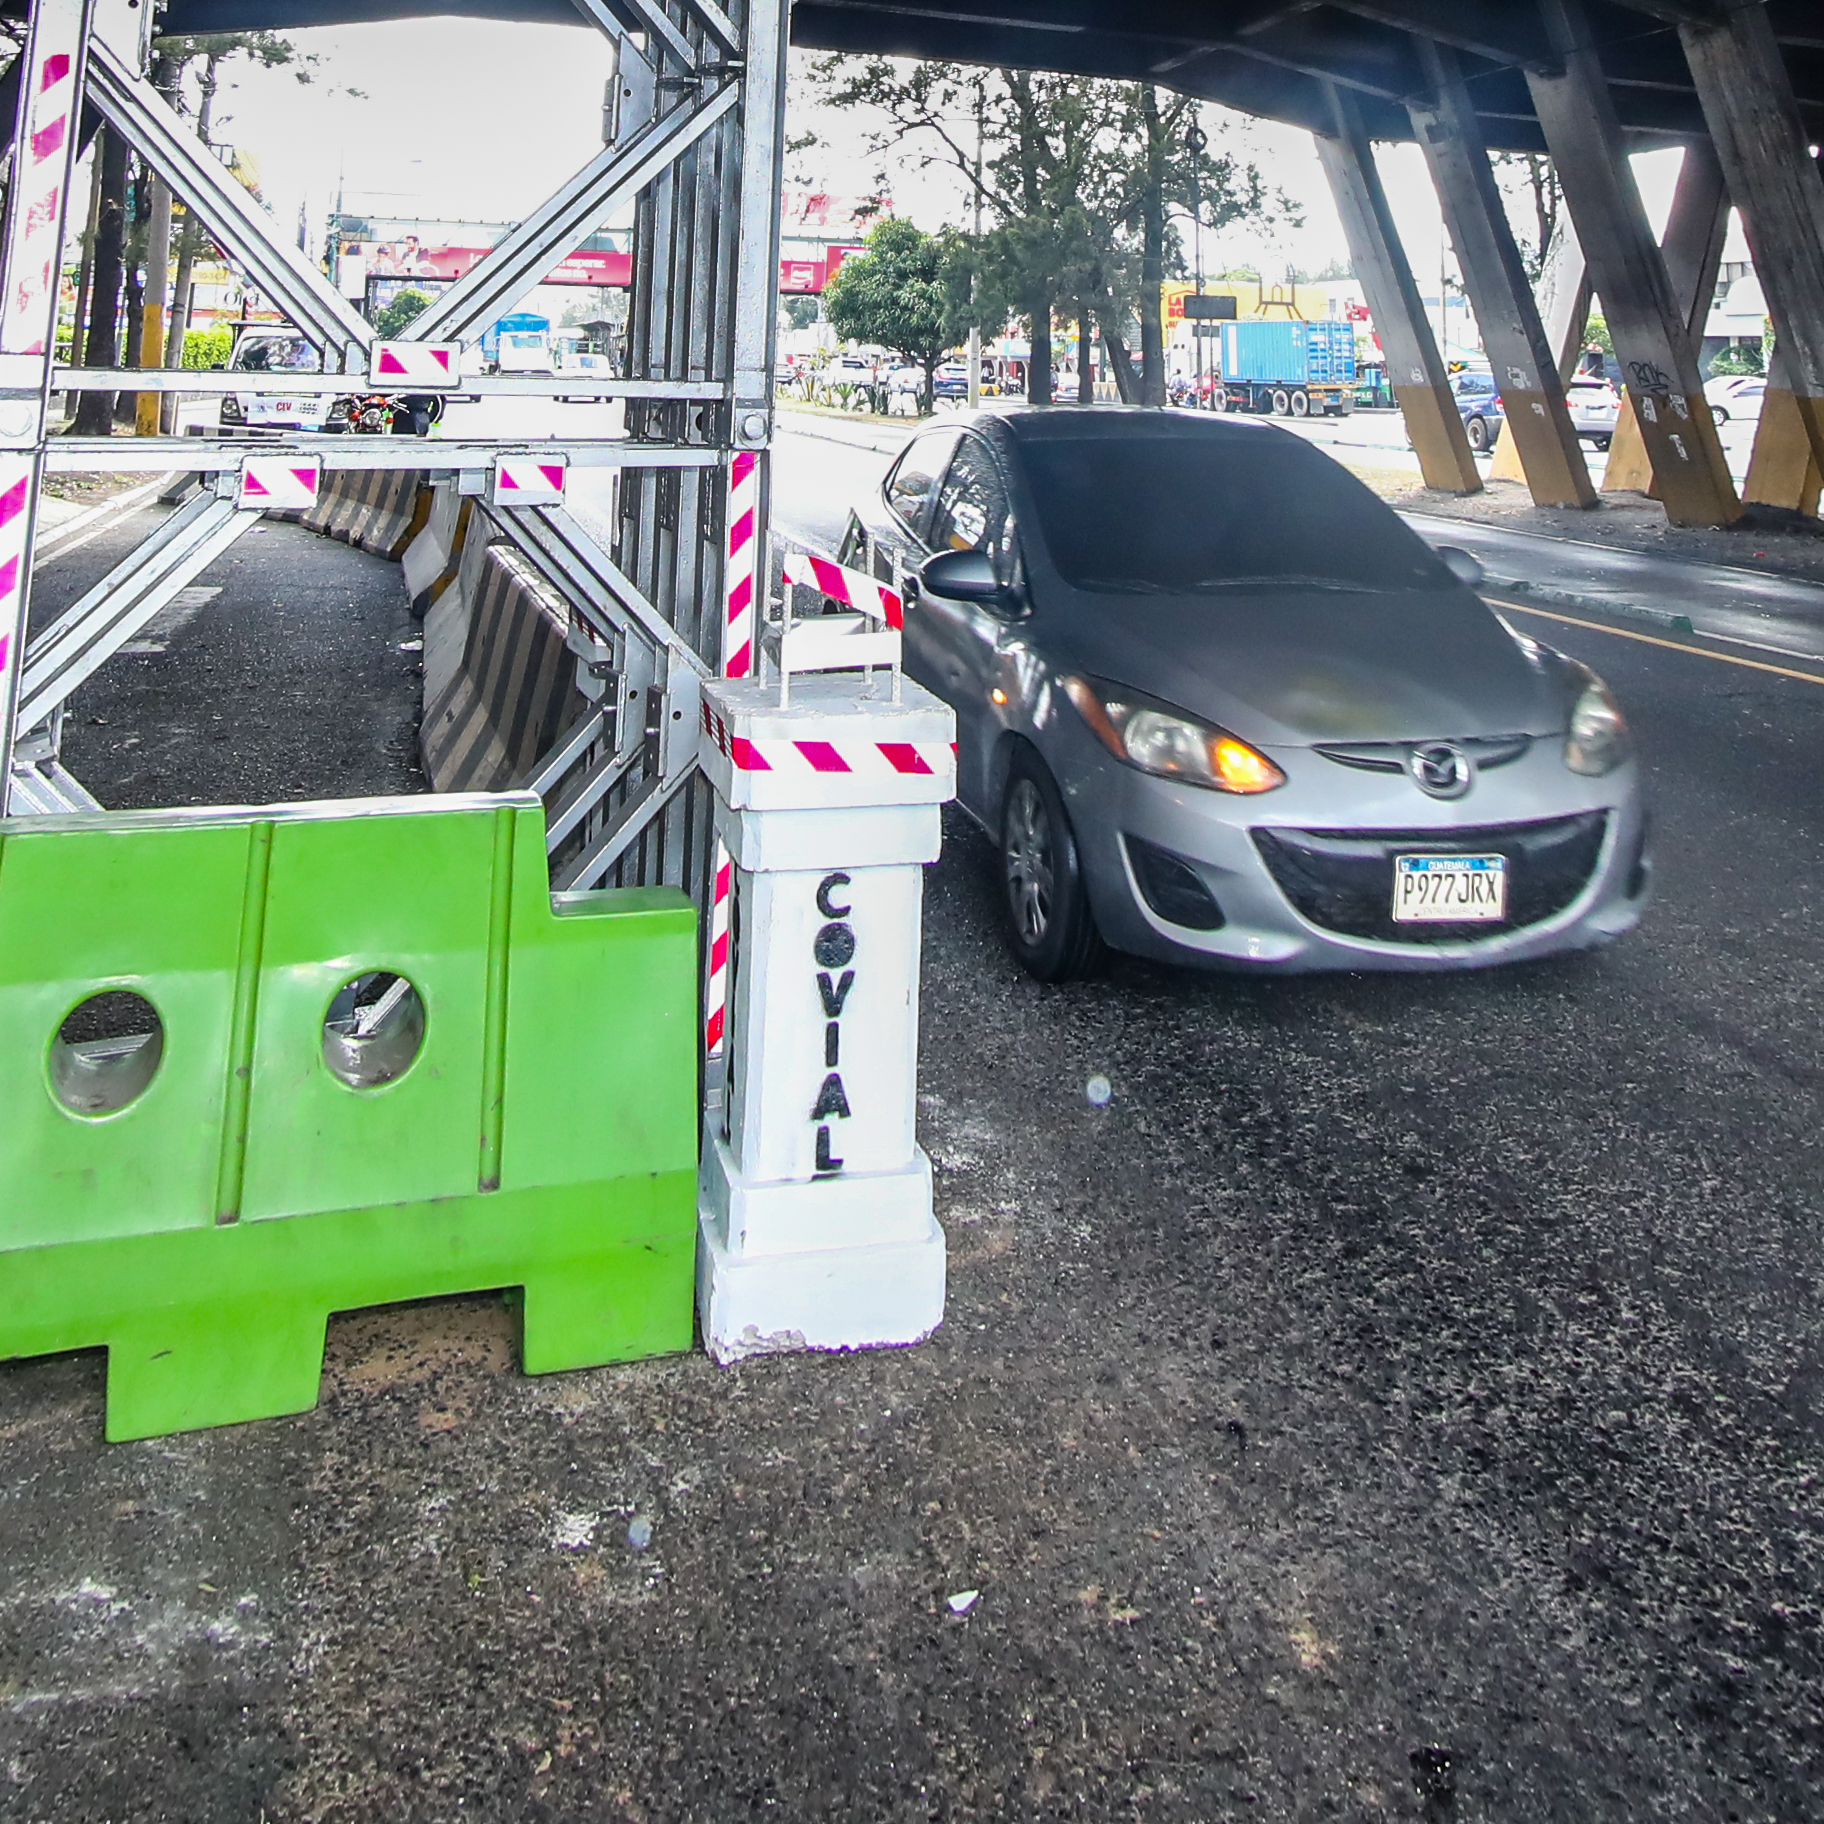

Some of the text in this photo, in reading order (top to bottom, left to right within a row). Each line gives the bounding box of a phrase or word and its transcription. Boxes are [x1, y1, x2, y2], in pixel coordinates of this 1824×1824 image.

[276, 402, 292, 411] CIV
[1428, 860, 1471, 871] GUATEMALA
[1403, 873, 1497, 905] P977JRX
[812, 872, 856, 1171] COVIAL
